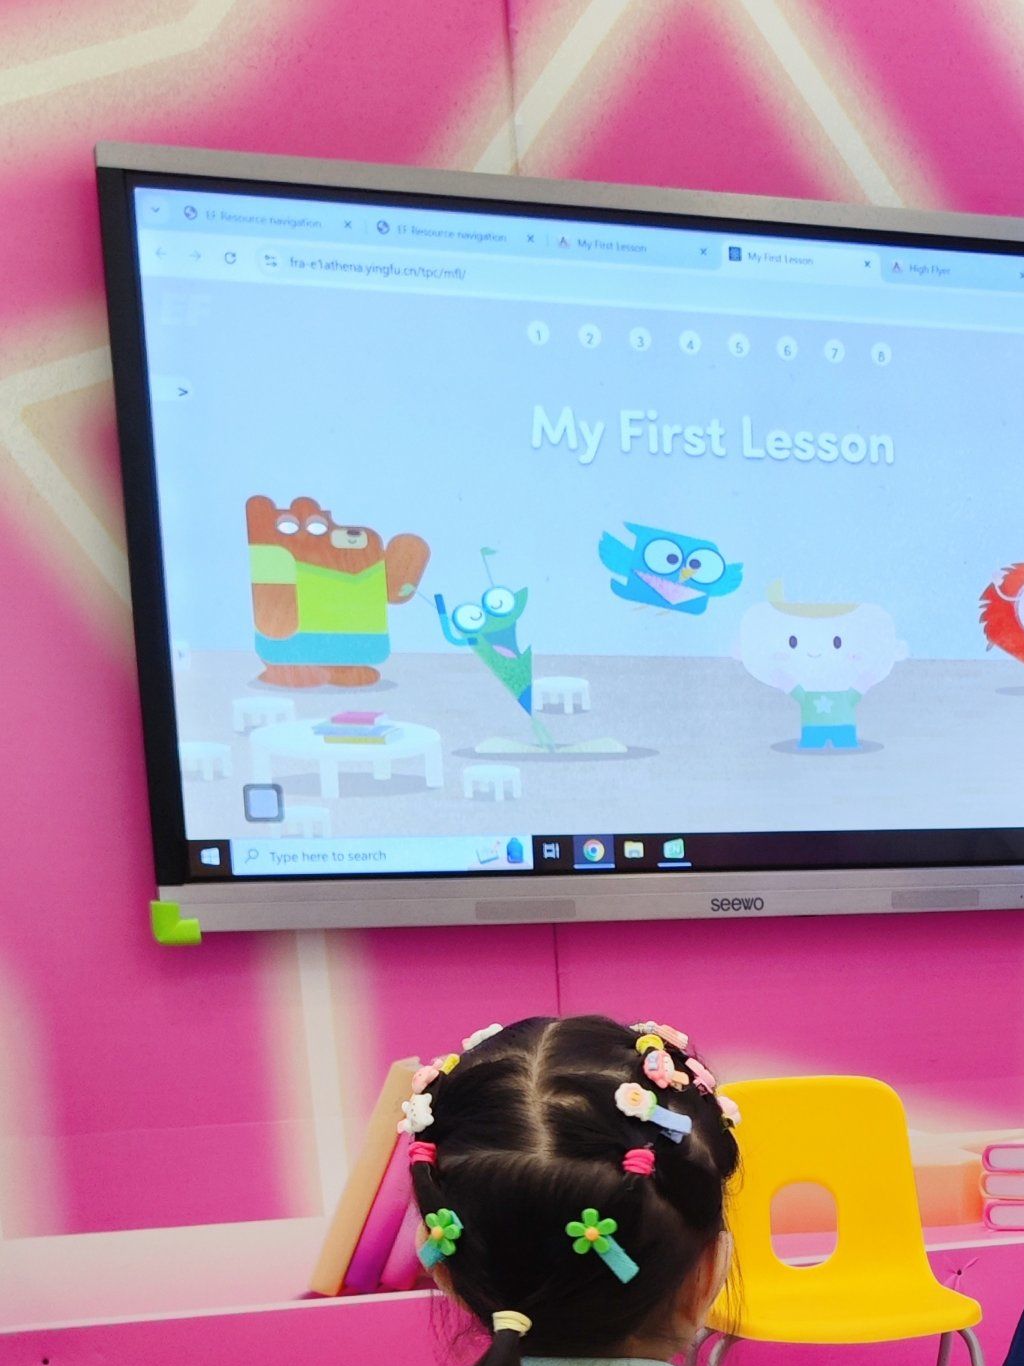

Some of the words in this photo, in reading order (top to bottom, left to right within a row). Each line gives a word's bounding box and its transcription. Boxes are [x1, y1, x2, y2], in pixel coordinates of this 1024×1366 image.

[577, 238, 592, 251] My
[594, 240, 614, 252] First
[616, 241, 647, 254] Lesson
[747, 250, 762, 264] My
[764, 252, 782, 264] First
[784, 254, 814, 267] Lesson
[909, 263, 929, 276] High
[530, 405, 606, 465] My
[619, 408, 727, 458] First
[742, 415, 894, 465] Lesson
[269, 848, 299, 865] Type
[302, 848, 329, 862] here
[331, 849, 343, 862] to
[348, 848, 387, 862] search
[712, 897, 763, 912] seewo
